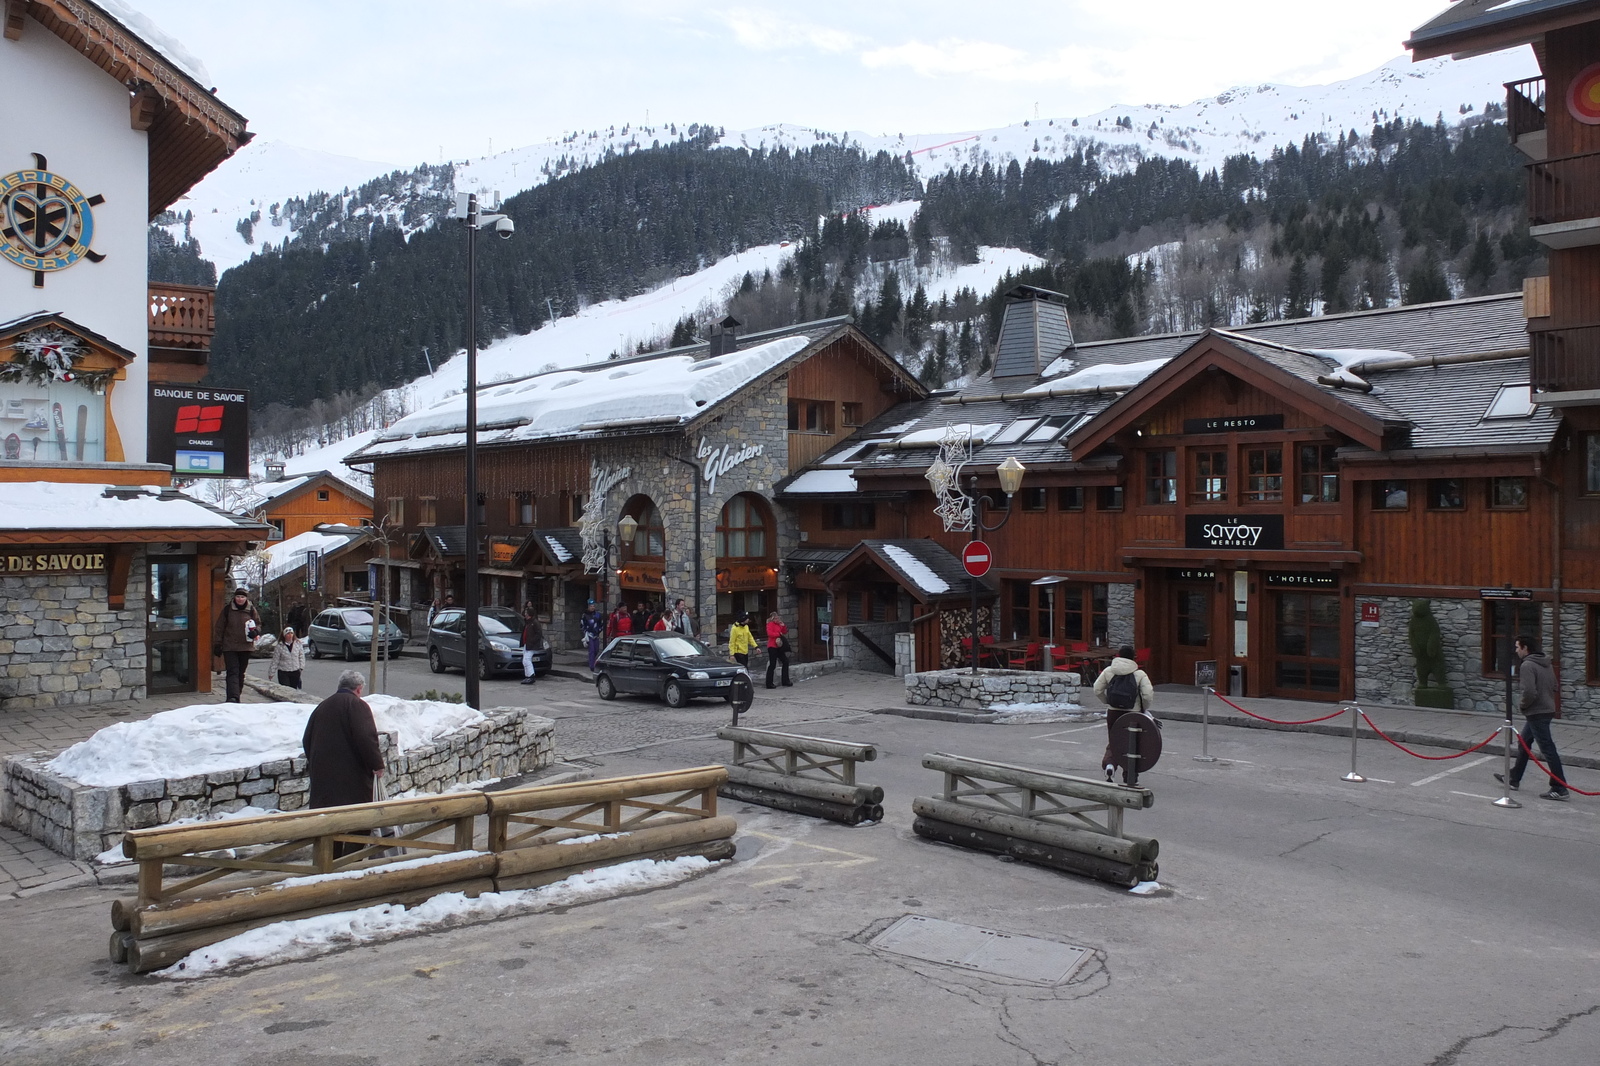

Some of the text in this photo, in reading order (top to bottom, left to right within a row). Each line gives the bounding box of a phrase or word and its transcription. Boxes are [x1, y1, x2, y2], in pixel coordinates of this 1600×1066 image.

[154, 388, 245, 403] BANQUE DE SAVOIE
[1224, 419, 1256, 427] RESTO
[704, 442, 764, 495] Glaciers
[8, 556, 33, 572] DE
[36, 553, 105, 571] SAVOIE
[1369, 606, 1377, 614] H
